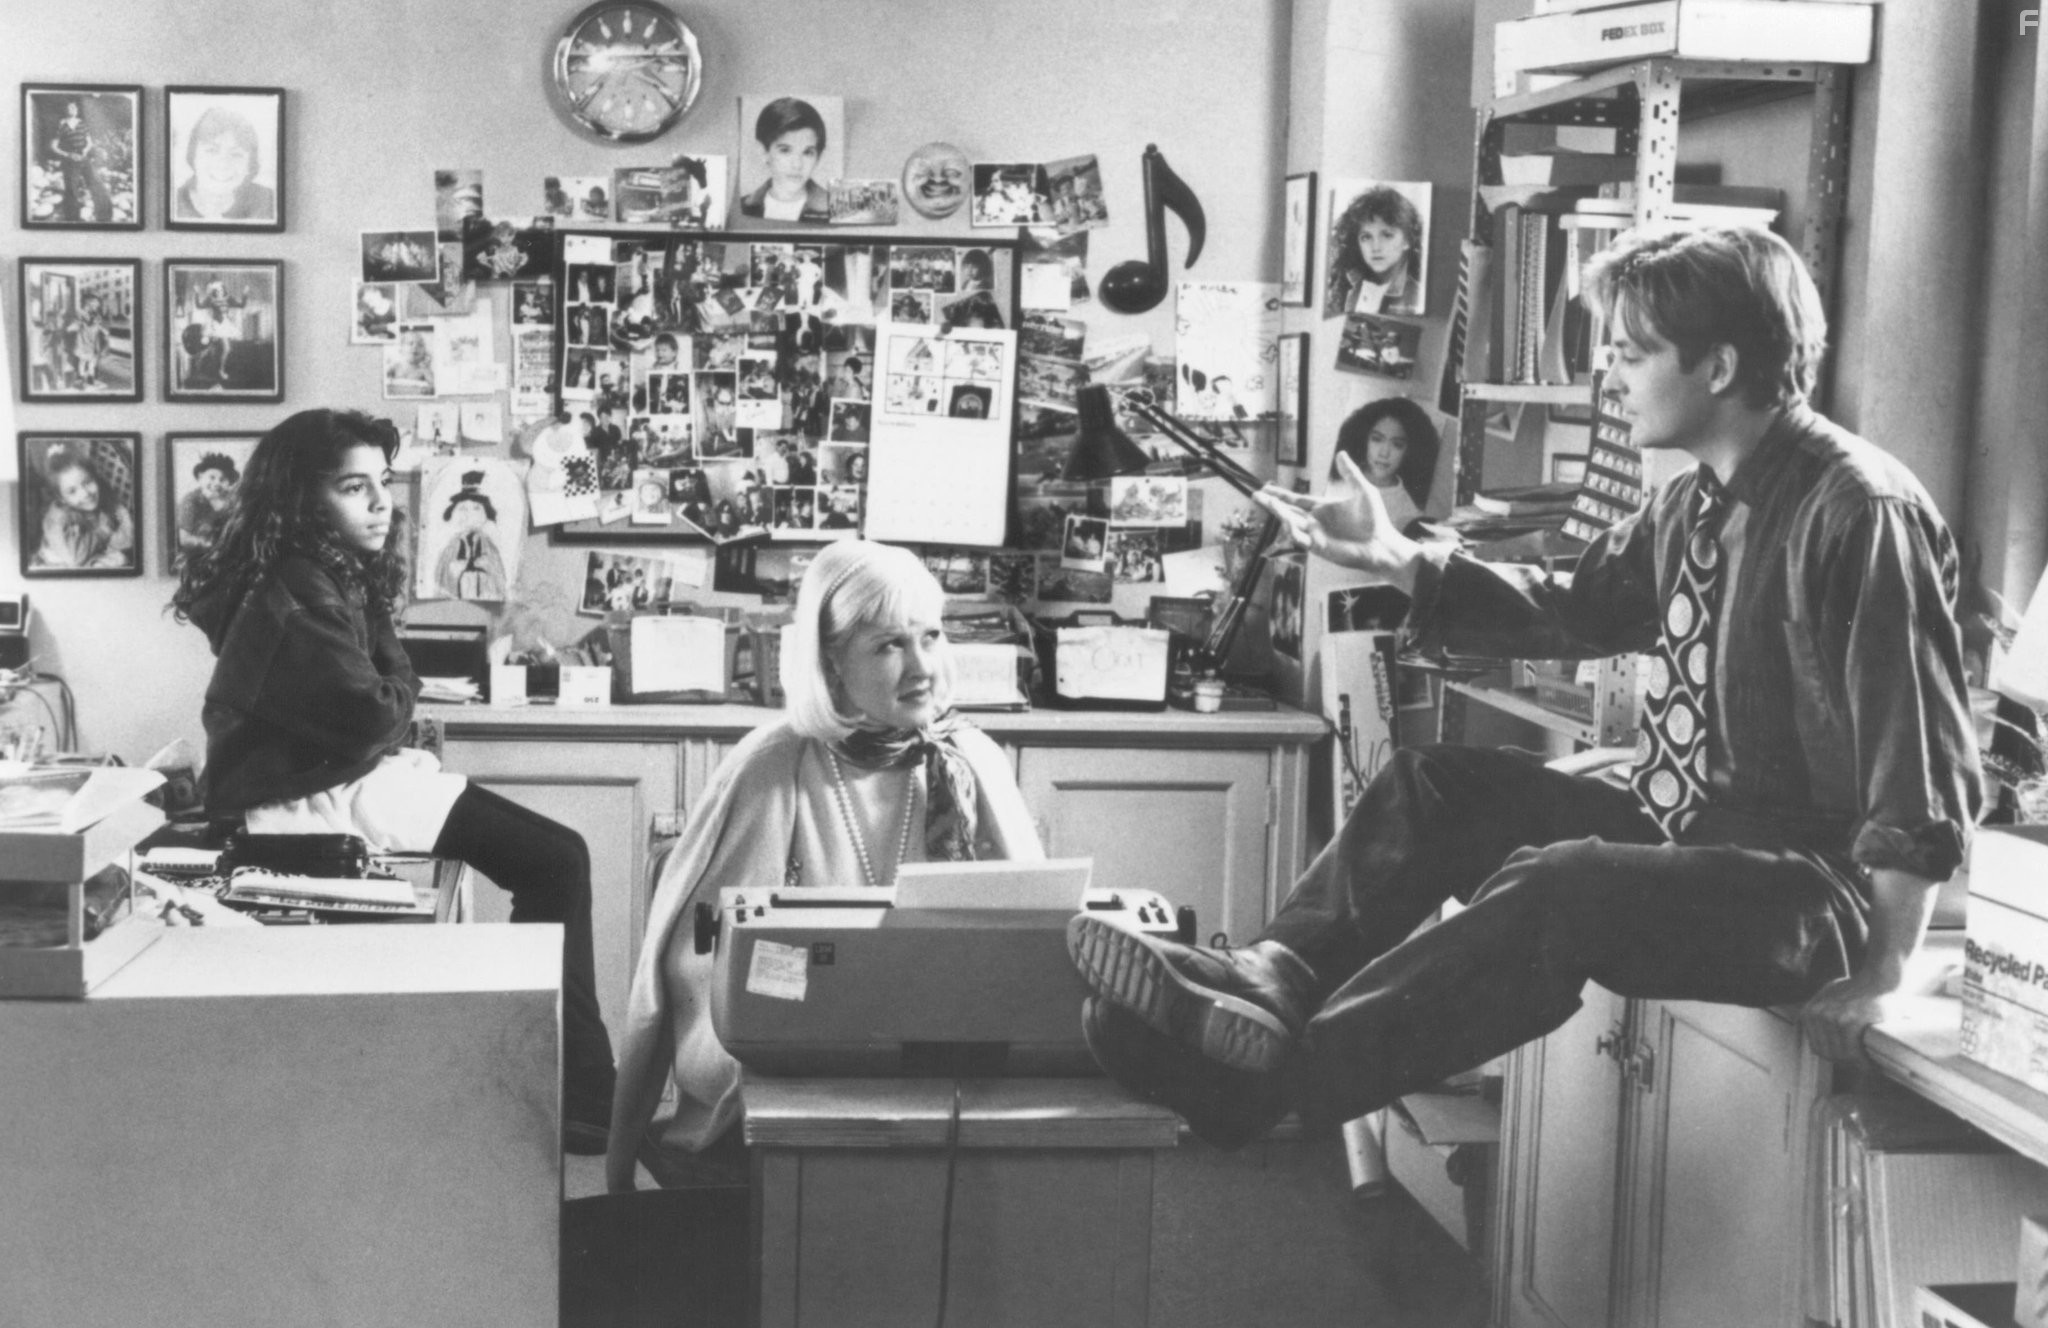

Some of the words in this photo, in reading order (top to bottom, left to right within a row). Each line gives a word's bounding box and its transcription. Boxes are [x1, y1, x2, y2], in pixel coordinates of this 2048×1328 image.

[1602, 26, 1638, 40] FEDEX
[1640, 21, 1666, 36] BOX
[1965, 938, 2031, 982] Recycled
